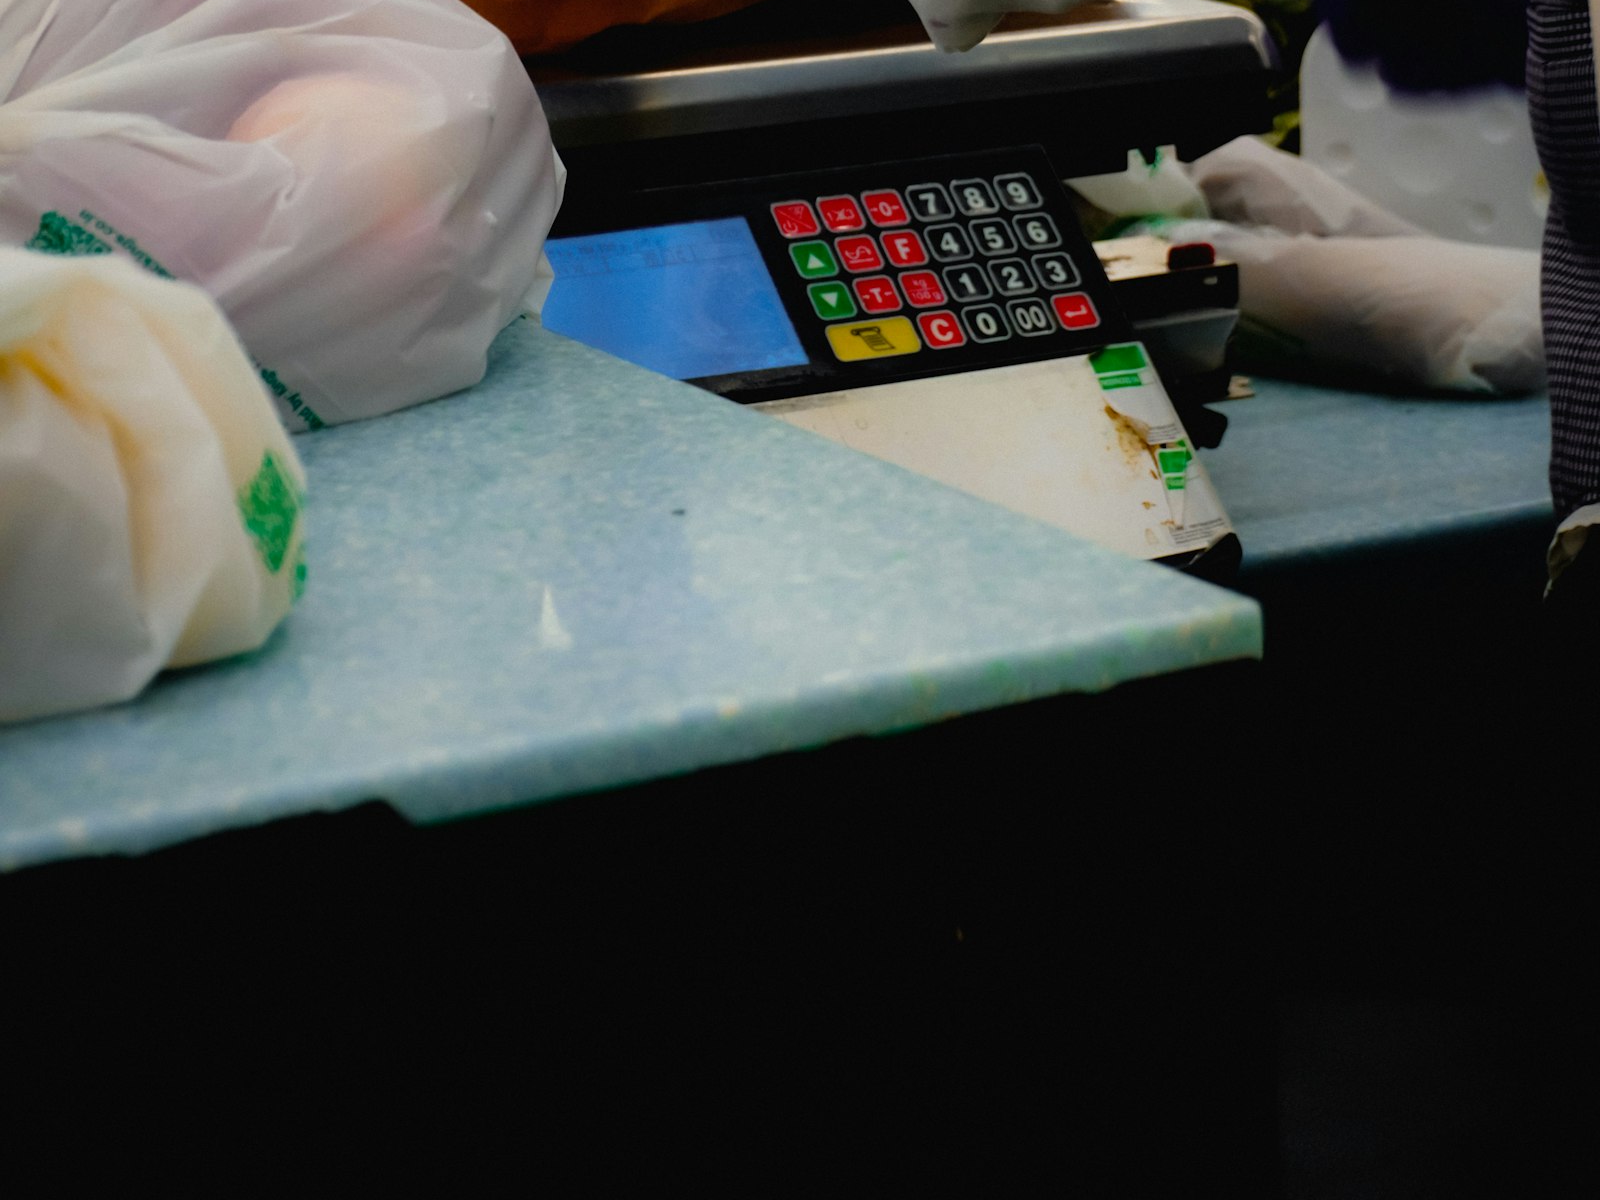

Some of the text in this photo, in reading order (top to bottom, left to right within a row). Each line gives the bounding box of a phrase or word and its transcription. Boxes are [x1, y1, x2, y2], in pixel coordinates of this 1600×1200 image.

[918, 182, 1028, 214] 7 8 9
[893, 238, 911, 261] F
[941, 221, 1048, 254] 4 5 6
[959, 261, 1067, 294] 1 2 3
[868, 287, 883, 304] T
[929, 305, 1047, 342] C 0 00
